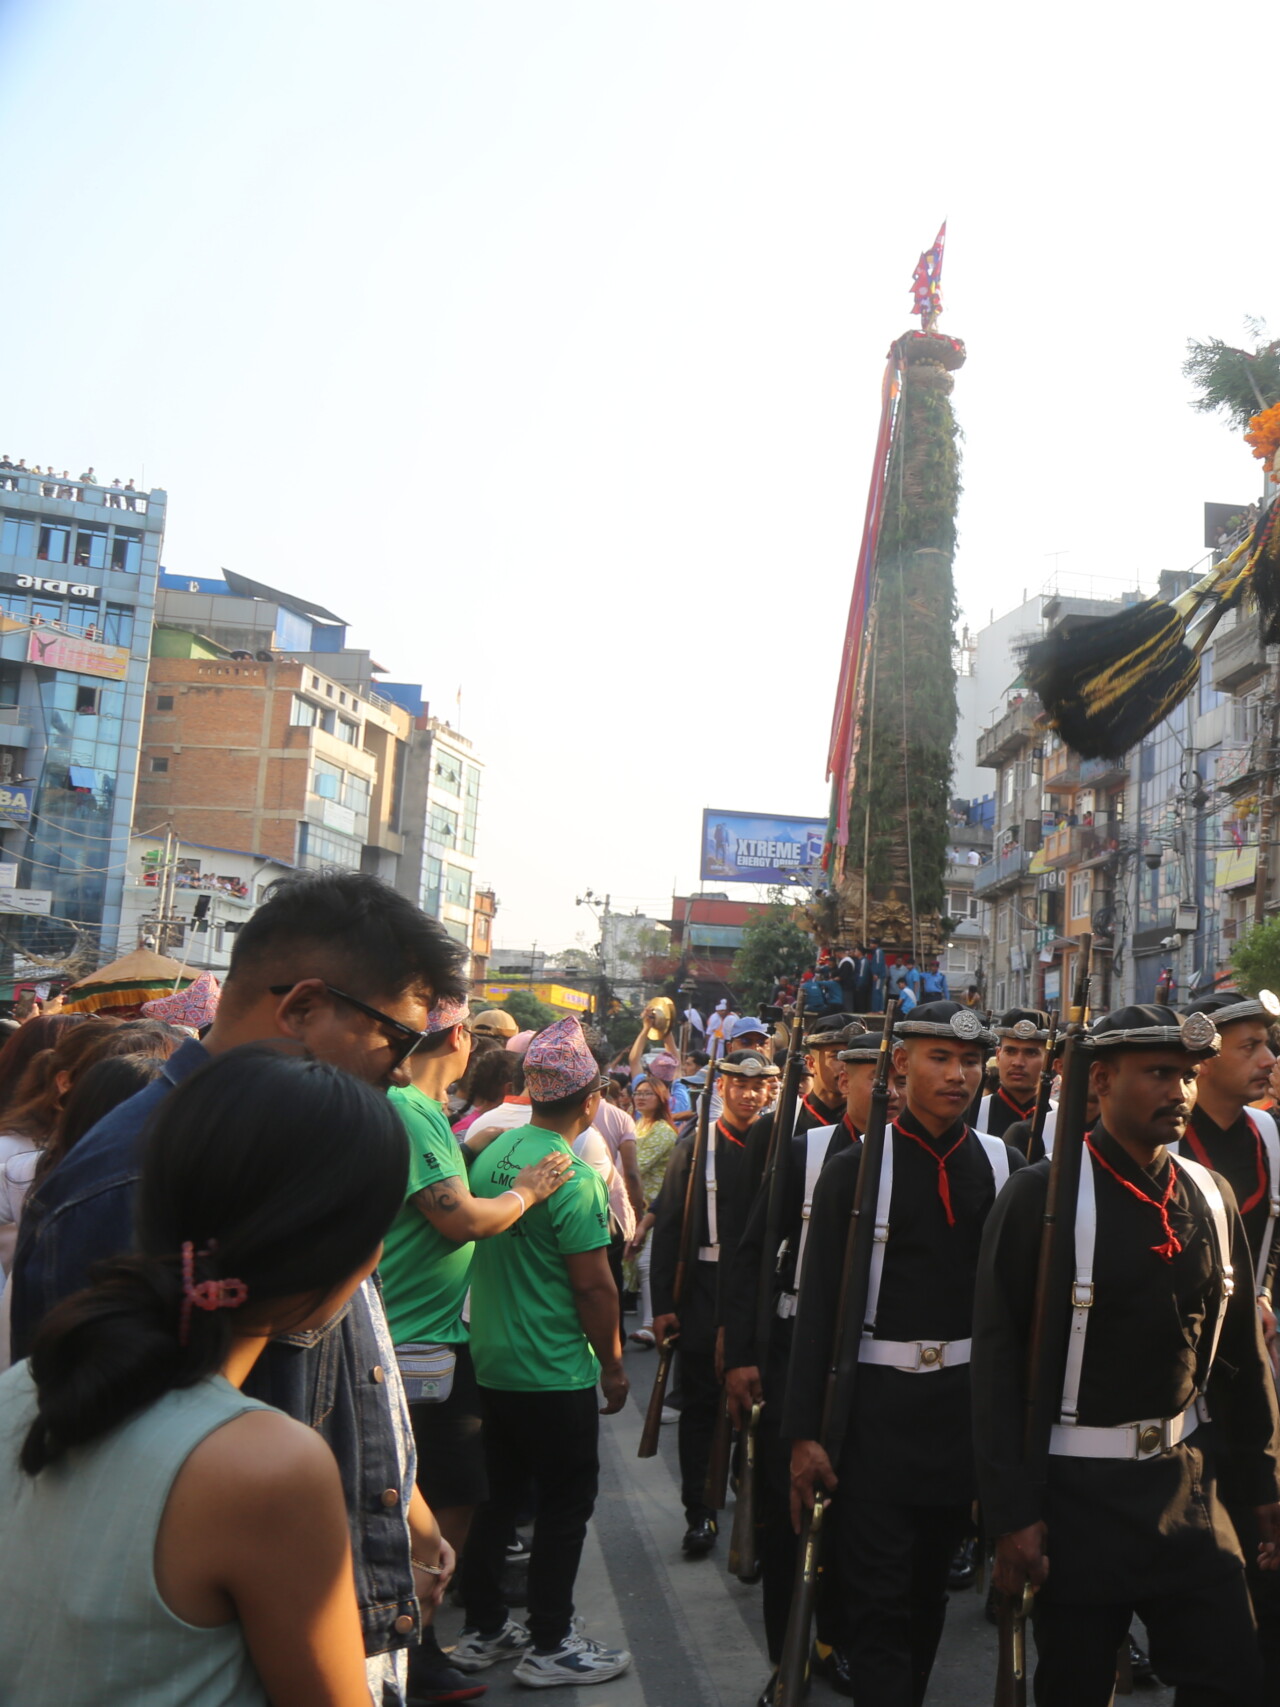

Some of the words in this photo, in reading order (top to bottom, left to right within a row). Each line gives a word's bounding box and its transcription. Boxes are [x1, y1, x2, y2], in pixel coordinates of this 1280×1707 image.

[16, 573, 100, 598] भवन
[737, 839, 801, 860] XTREME
[737, 855, 771, 868] ENERGY
